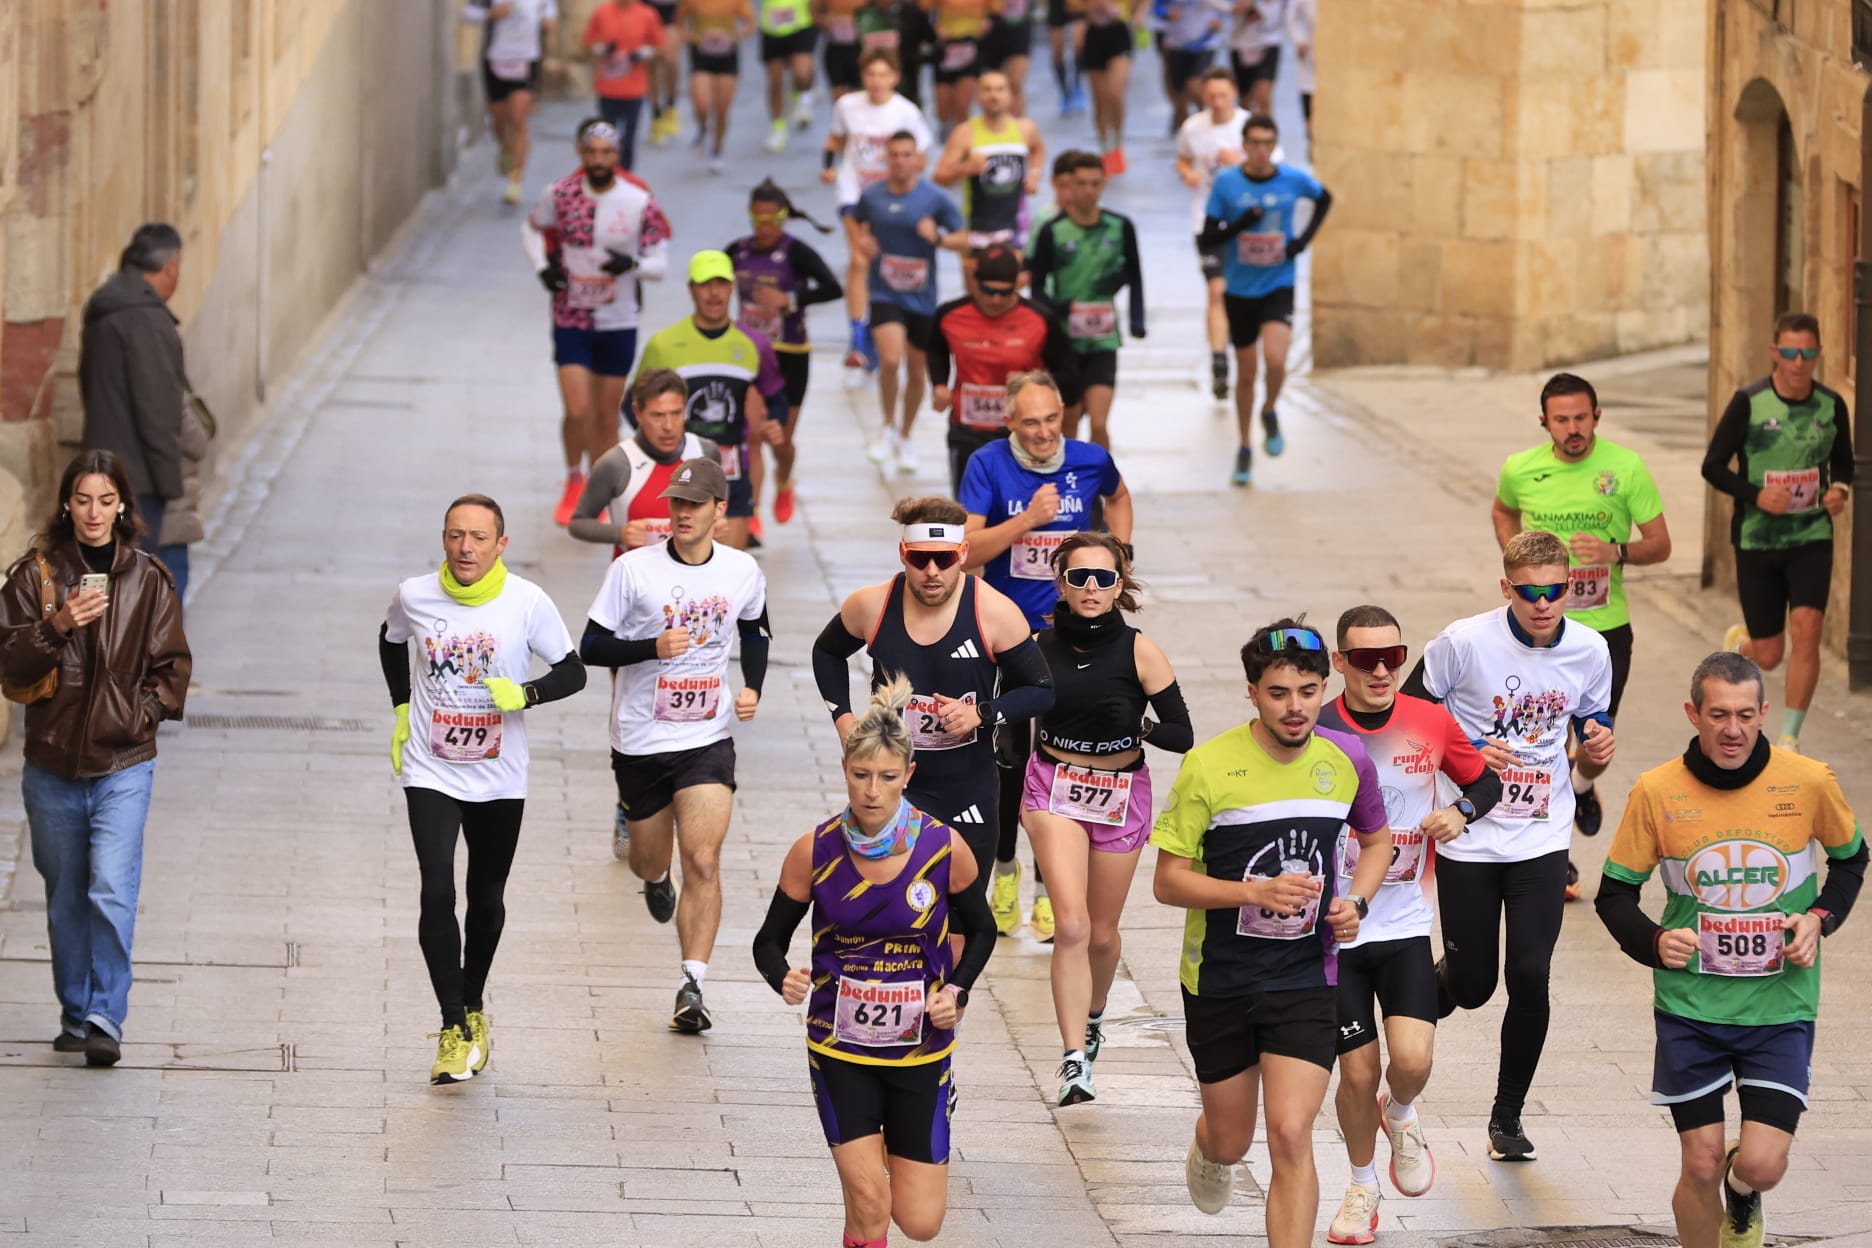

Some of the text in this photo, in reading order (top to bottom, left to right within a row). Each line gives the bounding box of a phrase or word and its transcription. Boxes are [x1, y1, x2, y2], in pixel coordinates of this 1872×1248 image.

[1008, 500, 1024, 515] LA
[658, 677, 720, 690] bedunia
[670, 691, 706, 708] 391
[432, 709, 502, 727] bedunia
[444, 727, 487, 746] 479
[1053, 736, 1093, 752] NIKE
[1095, 736, 1132, 753] PRO
[1057, 765, 1129, 789] bedunia
[1405, 760, 1434, 774] club
[1068, 783, 1113, 807] 577
[1682, 828, 1791, 858] CLUB DEPORTIVO
[1696, 866, 1779, 888] ALCER
[1701, 914, 1783, 934] bedunia
[1718, 934, 1767, 956] 508
[840, 980, 922, 1003] bedunia
[854, 1002, 902, 1027] 621
